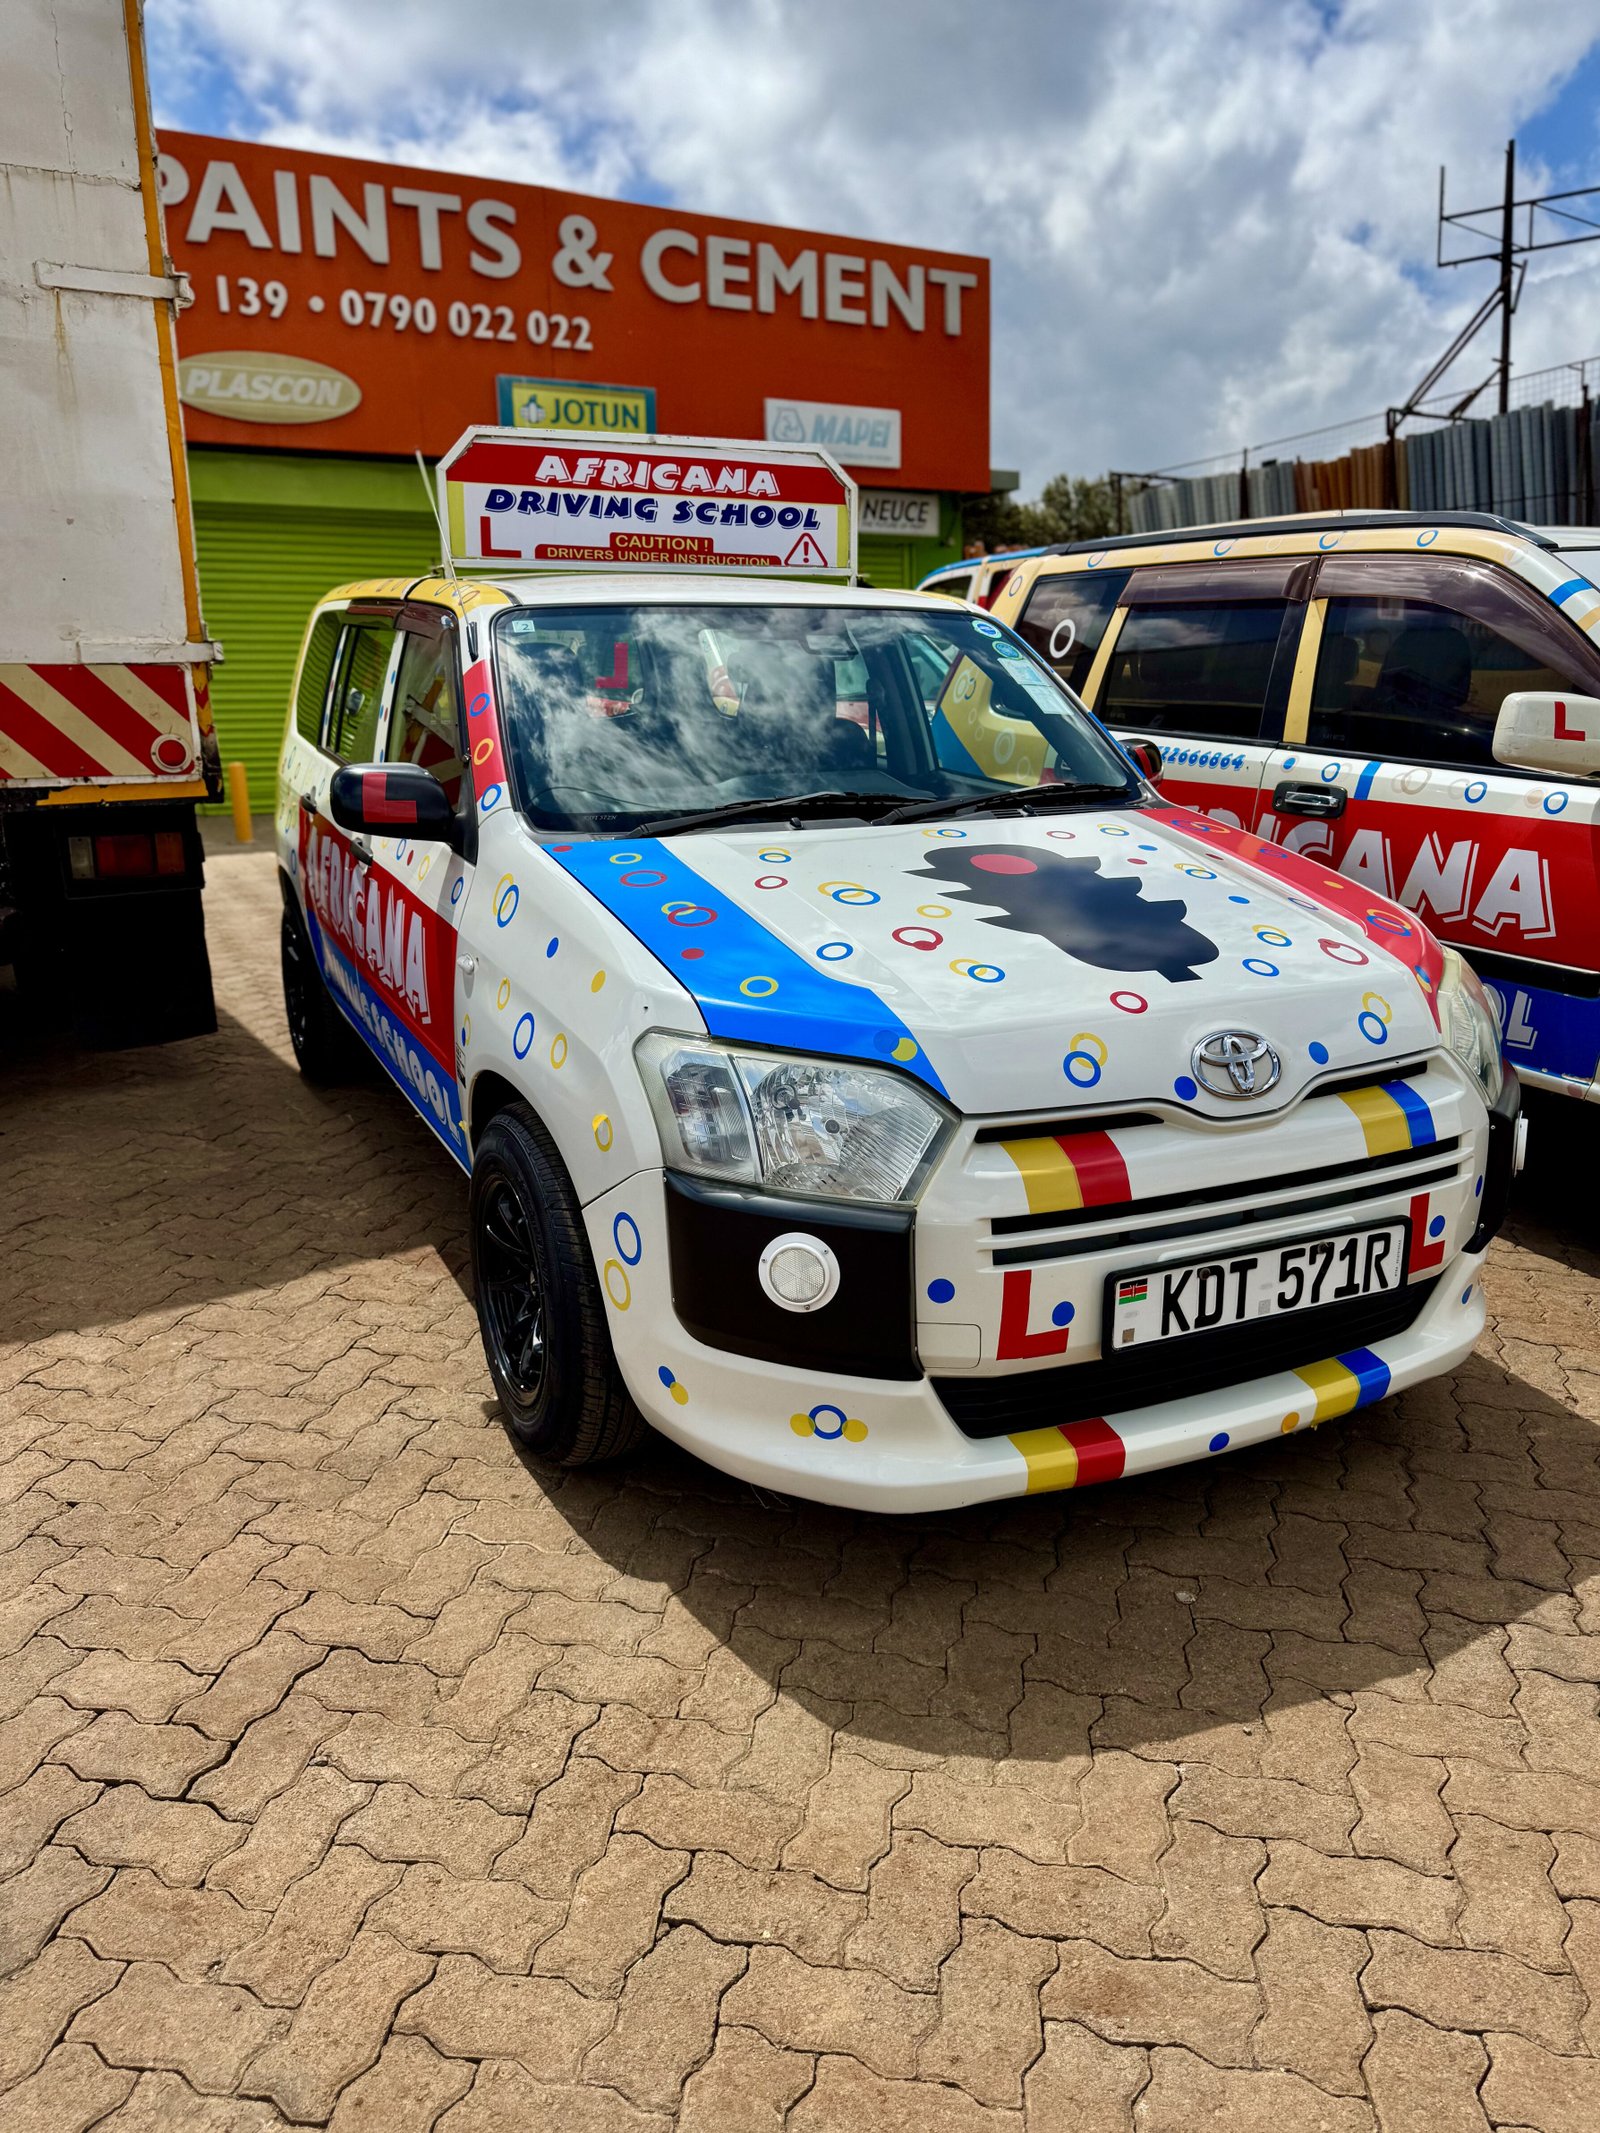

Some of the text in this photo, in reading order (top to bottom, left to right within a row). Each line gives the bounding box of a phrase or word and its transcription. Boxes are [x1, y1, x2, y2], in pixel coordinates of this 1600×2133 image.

[552, 213, 614, 291] &
[640, 228, 978, 336] CEMENT
[215, 275, 288, 319] 139
[340, 289, 436, 334] 0790
[448, 301, 517, 342] 022
[526, 308, 593, 350] 022
[186, 368, 342, 407] PLASCON
[551, 398, 640, 429] JOTUN
[810, 414, 892, 448] MAPEI
[535, 454, 781, 497] AFRICANA
[484, 488, 821, 530] DRIVING SCHOOL
[862, 498, 930, 523] NEUCE
[480, 516, 522, 558] L
[547, 547, 770, 566] DRIVERS UNDER INSTRUCTION
[615, 534, 698, 551] CAUTION
[1554, 701, 1586, 741] L
[1158, 745, 1247, 771] 22666864
[362, 771, 417, 823] L
[305, 824, 432, 1025] AFRICANA
[371, 1002, 462, 1147] SCHOOL
[1407, 1191, 1446, 1275] L
[1161, 1257, 1258, 1336] KDT
[1277, 1231, 1392, 1310] 571R
[996, 1269, 1069, 1361] L
